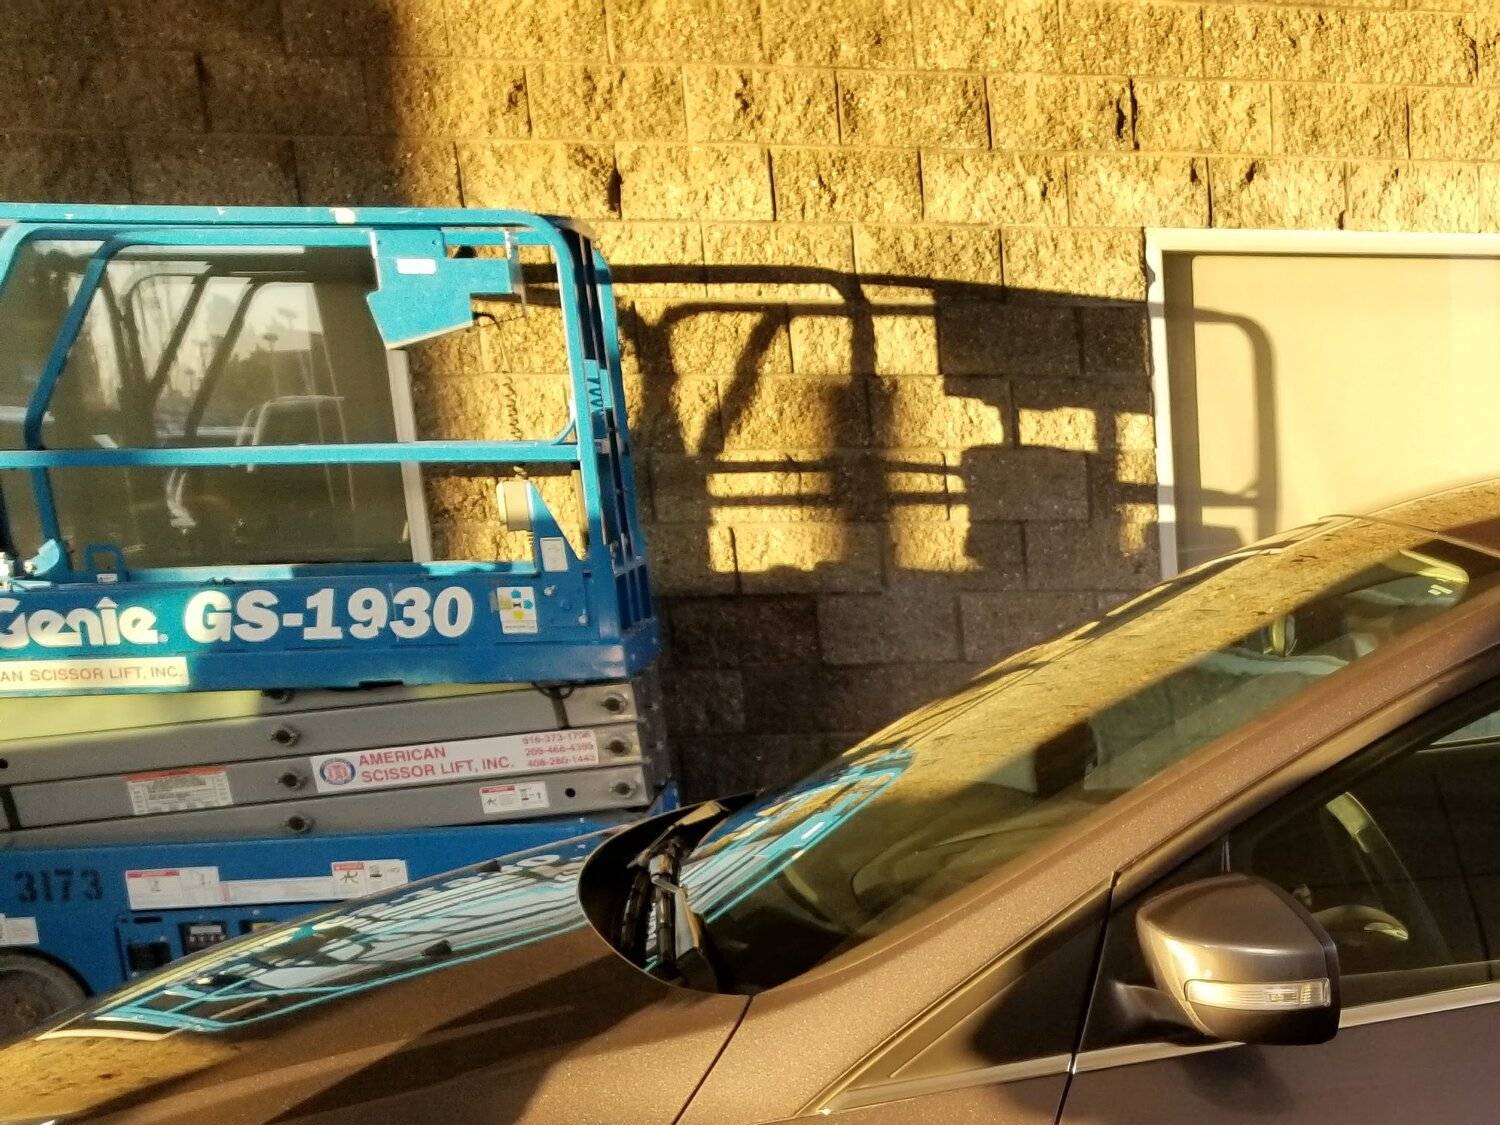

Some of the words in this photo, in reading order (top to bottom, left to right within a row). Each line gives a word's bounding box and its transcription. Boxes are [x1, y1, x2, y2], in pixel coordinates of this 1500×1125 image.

[184, 586, 474, 643] GS-1930
[29, 667, 104, 682] SCISSOR
[108, 666, 147, 682] LIFT,
[150, 664, 184, 680] INC.
[358, 746, 446, 767] AMERICAN
[360, 764, 437, 784] SCISSOR
[441, 758, 479, 776] LIFT,
[481, 755, 515, 771] INC.
[14, 868, 103, 902] 3173
